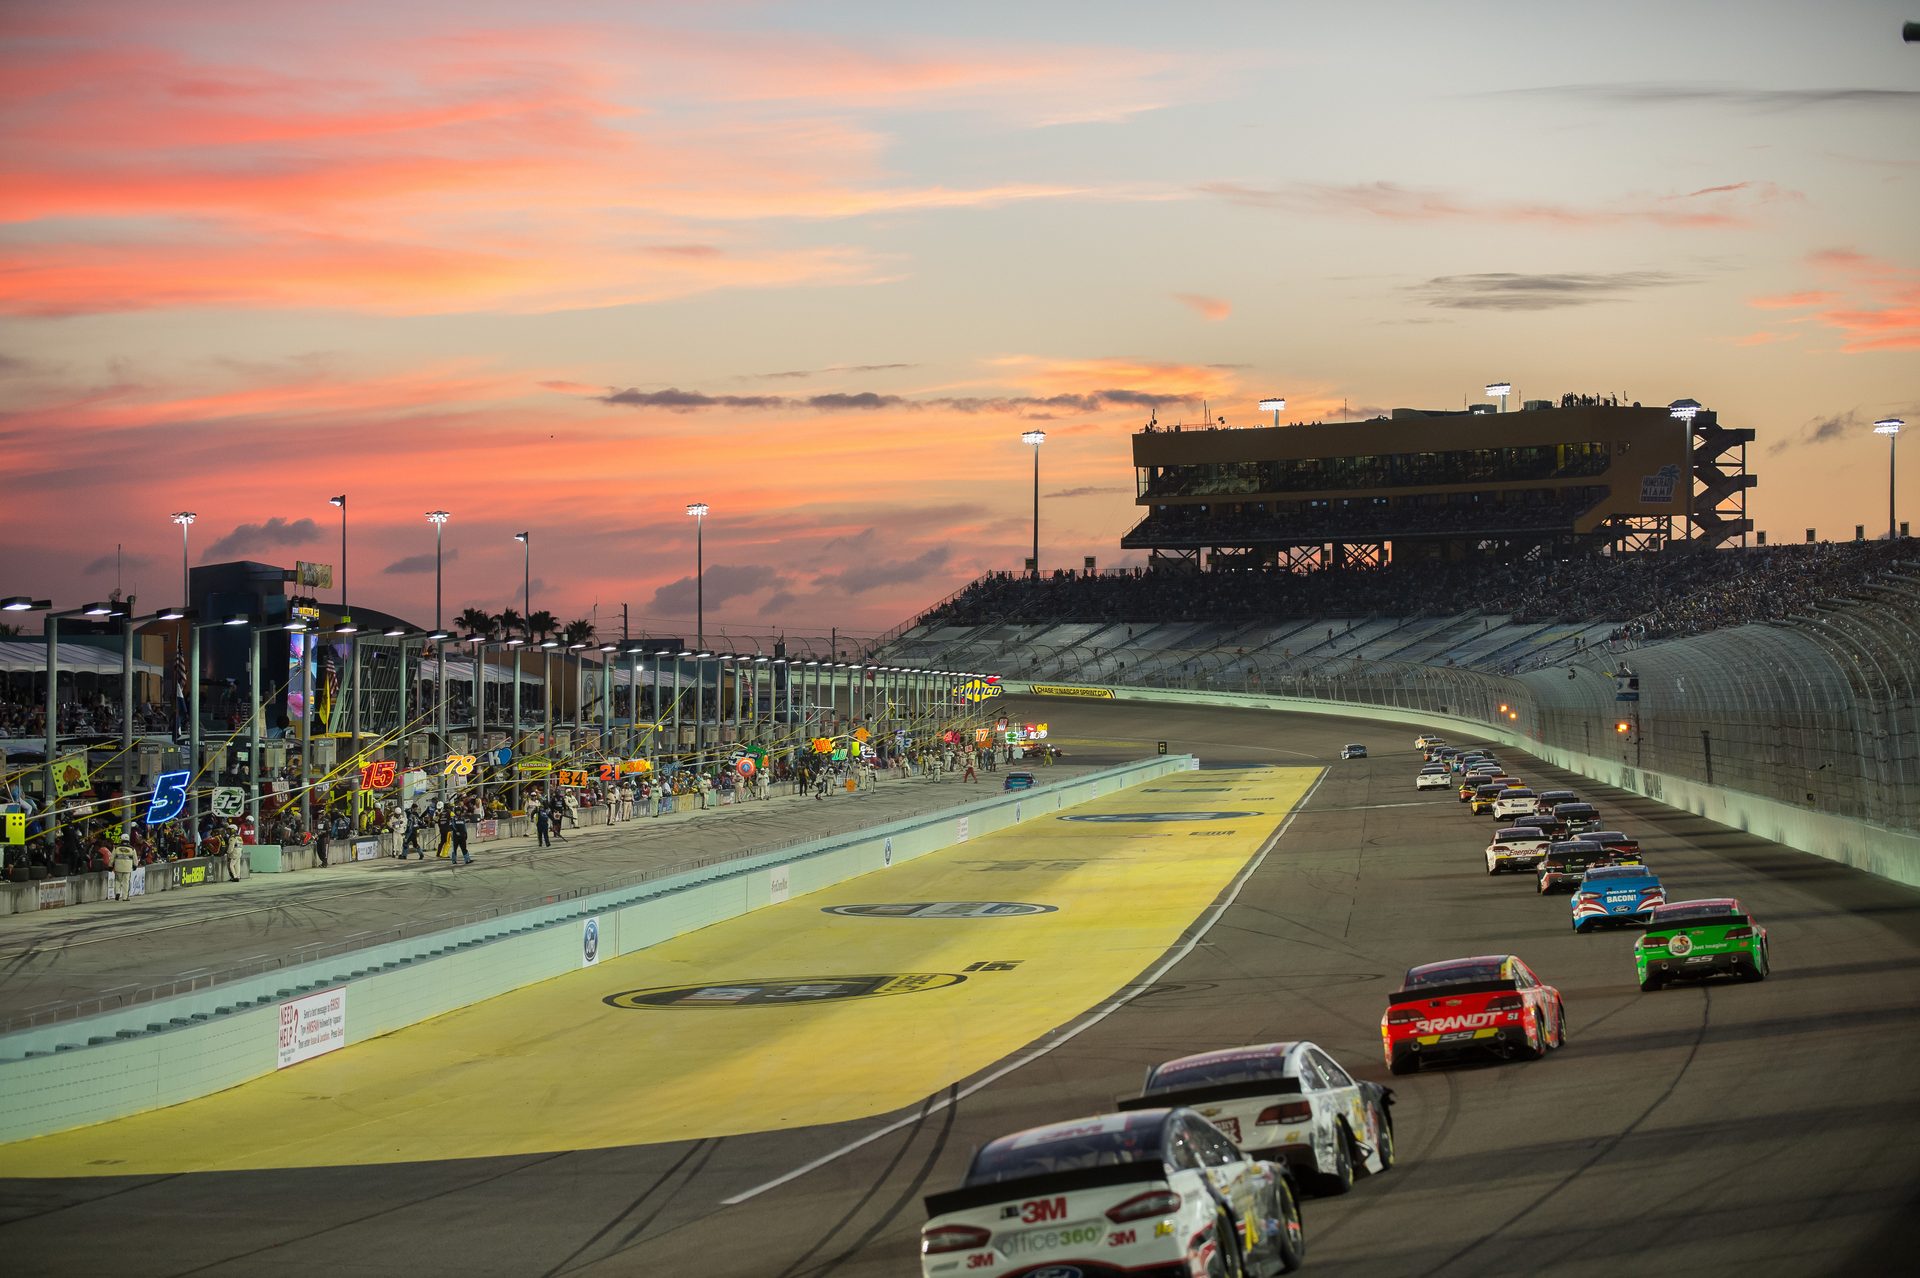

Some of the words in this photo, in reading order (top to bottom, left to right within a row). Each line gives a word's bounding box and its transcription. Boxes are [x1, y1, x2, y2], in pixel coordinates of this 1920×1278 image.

[1642, 487, 1670, 496] MIAMI
[444, 754, 477, 775] 78
[600, 764, 621, 781] 21
[361, 761, 396, 789] 15
[563, 771, 583, 787] 34
[146, 771, 191, 824] 5
[214, 794, 241, 809] 32
[1509, 848, 1540, 857] Energizer
[1606, 894, 1637, 904] BACON!
[281, 1005, 293, 1025] NEED
[1411, 1012, 1503, 1034] BRANDT
[1507, 1013, 1519, 1021] 51
[280, 1026, 293, 1048] HELP
[1439, 1031, 1474, 1043] SS
[1021, 1196, 1067, 1224] 3M
[1108, 1229, 1137, 1247] 3M
[966, 1252, 994, 1269] 3M
